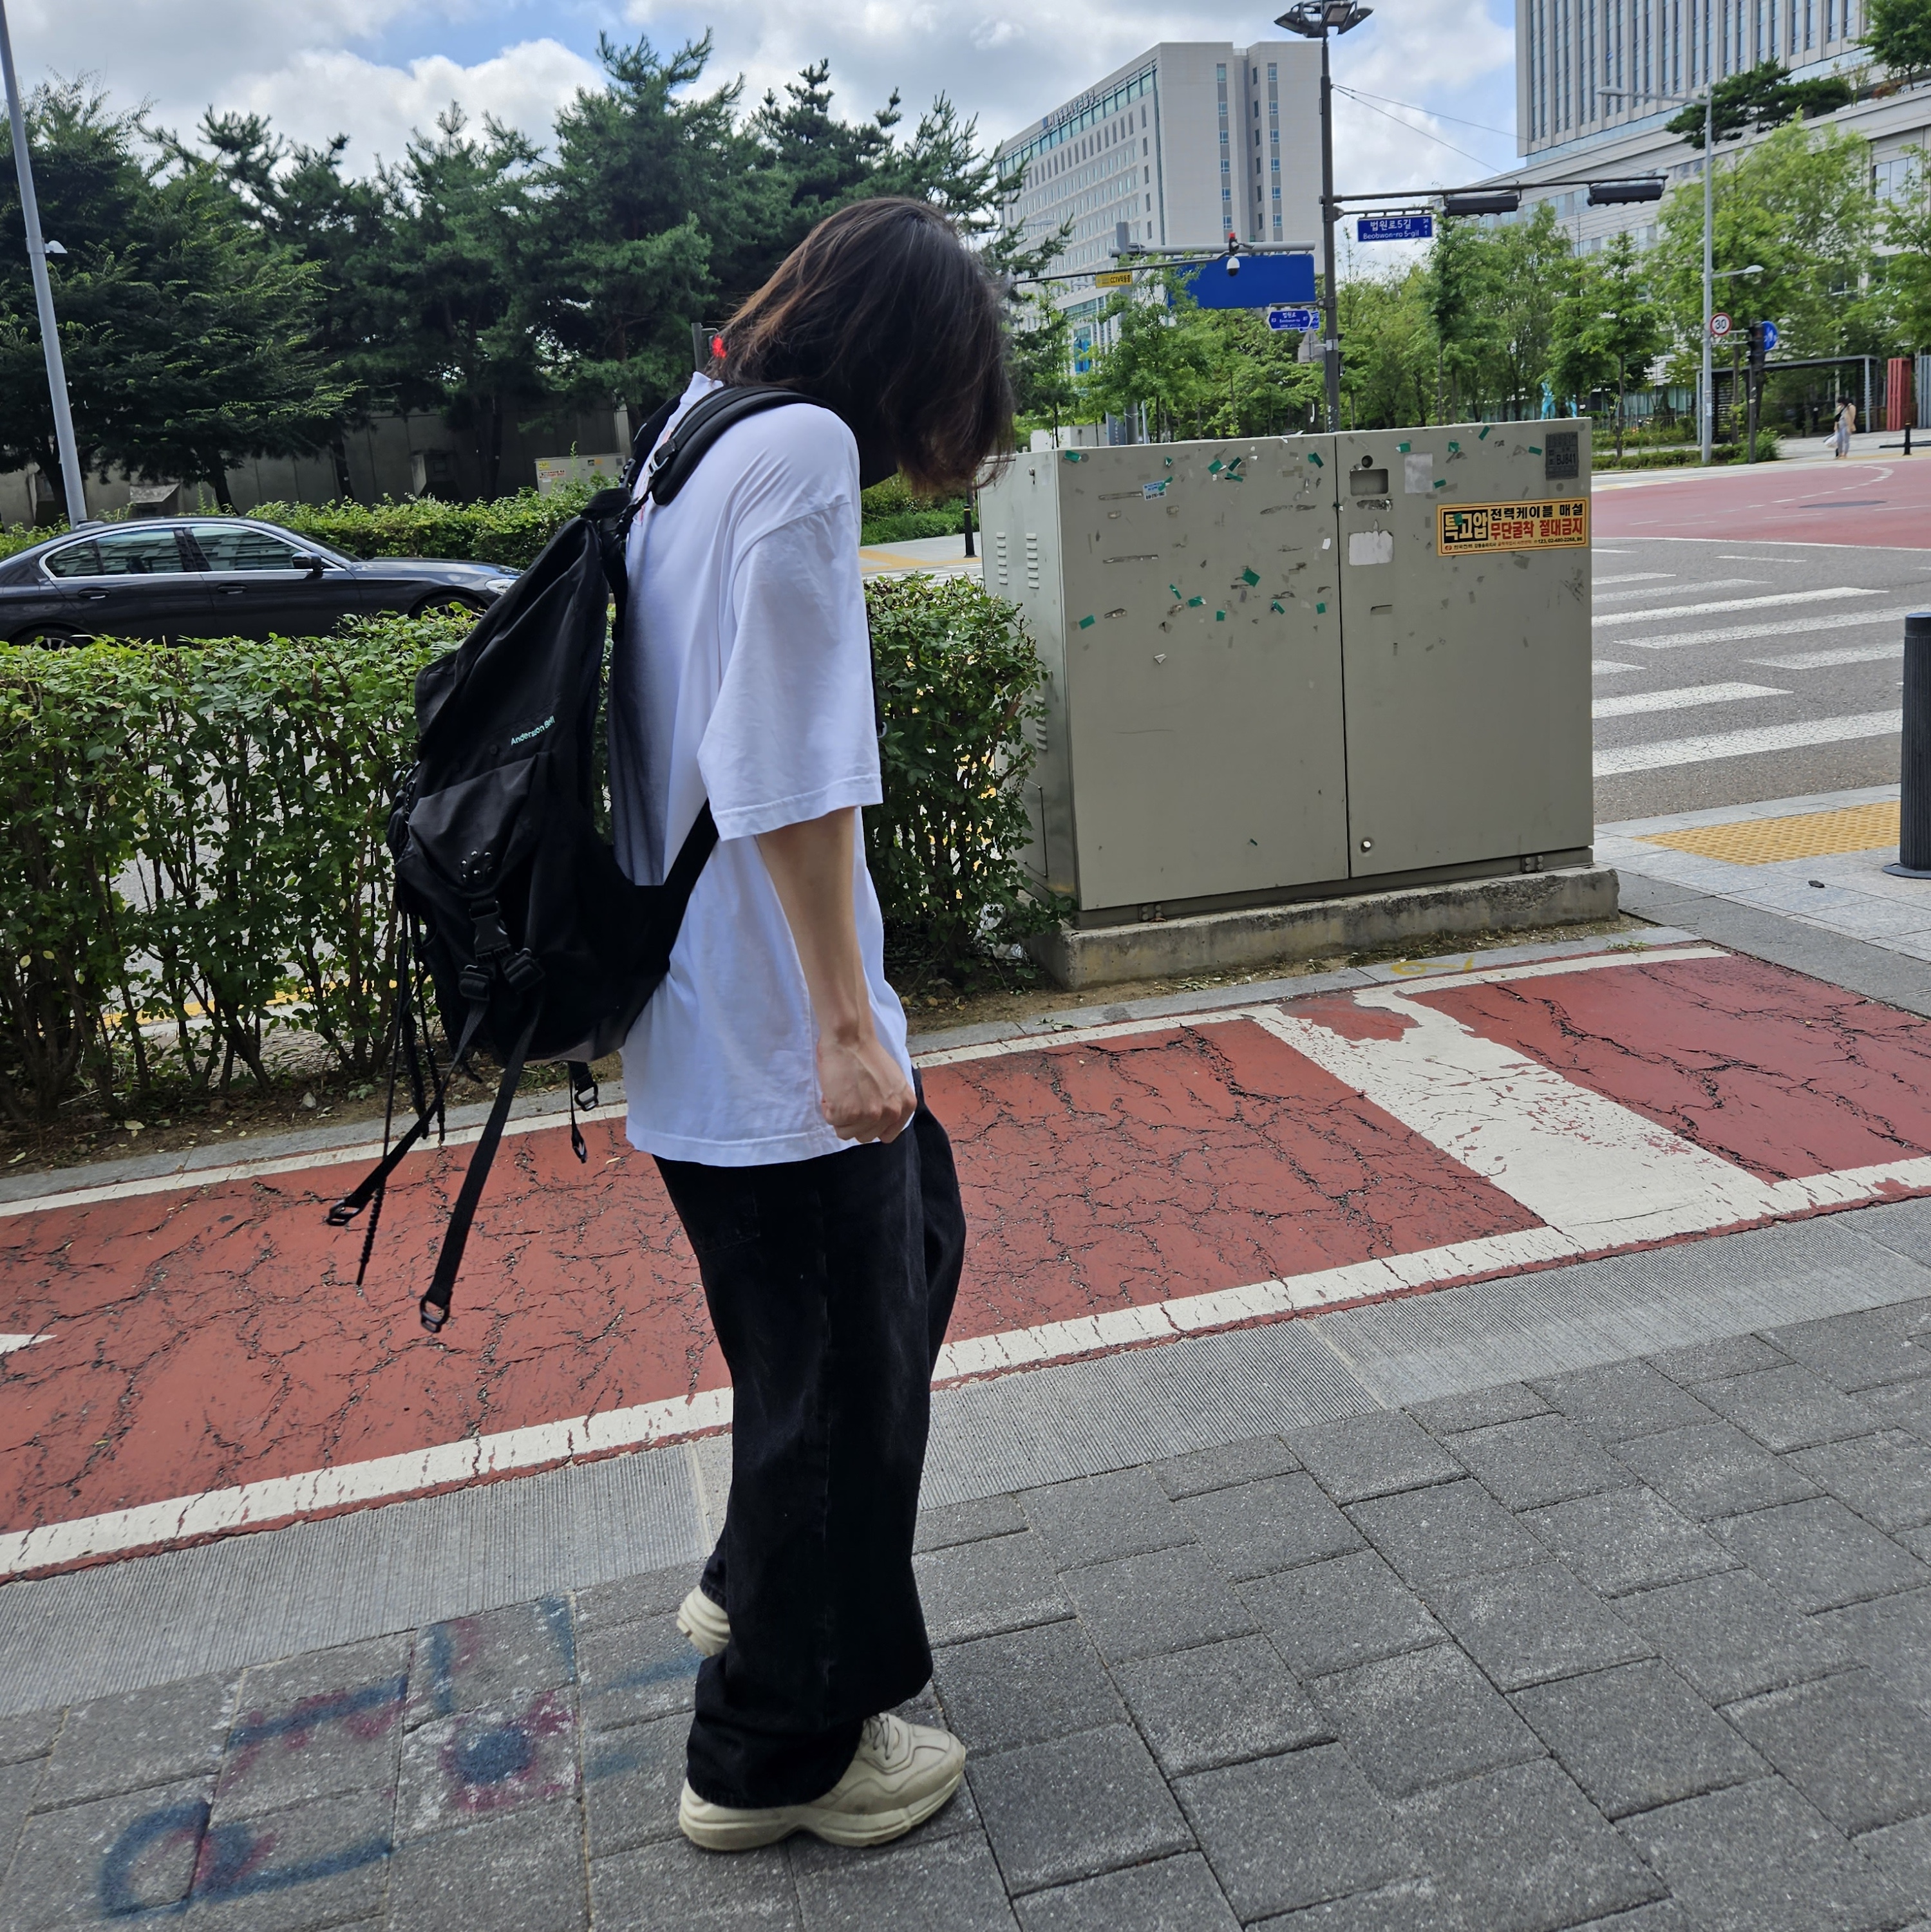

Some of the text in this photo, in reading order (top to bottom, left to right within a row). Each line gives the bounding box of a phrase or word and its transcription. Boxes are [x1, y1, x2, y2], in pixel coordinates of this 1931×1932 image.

[1370, 219, 1411, 232] 법원로5길
[1362, 231, 1403, 239] Beobwon-ro
[1715, 319, 1727, 330] 30
[1490, 503, 1583, 521] 전력케이블 매설
[1444, 512, 1488, 541] 특고압
[1491, 517, 1583, 541] 무단굴착 절대금지
